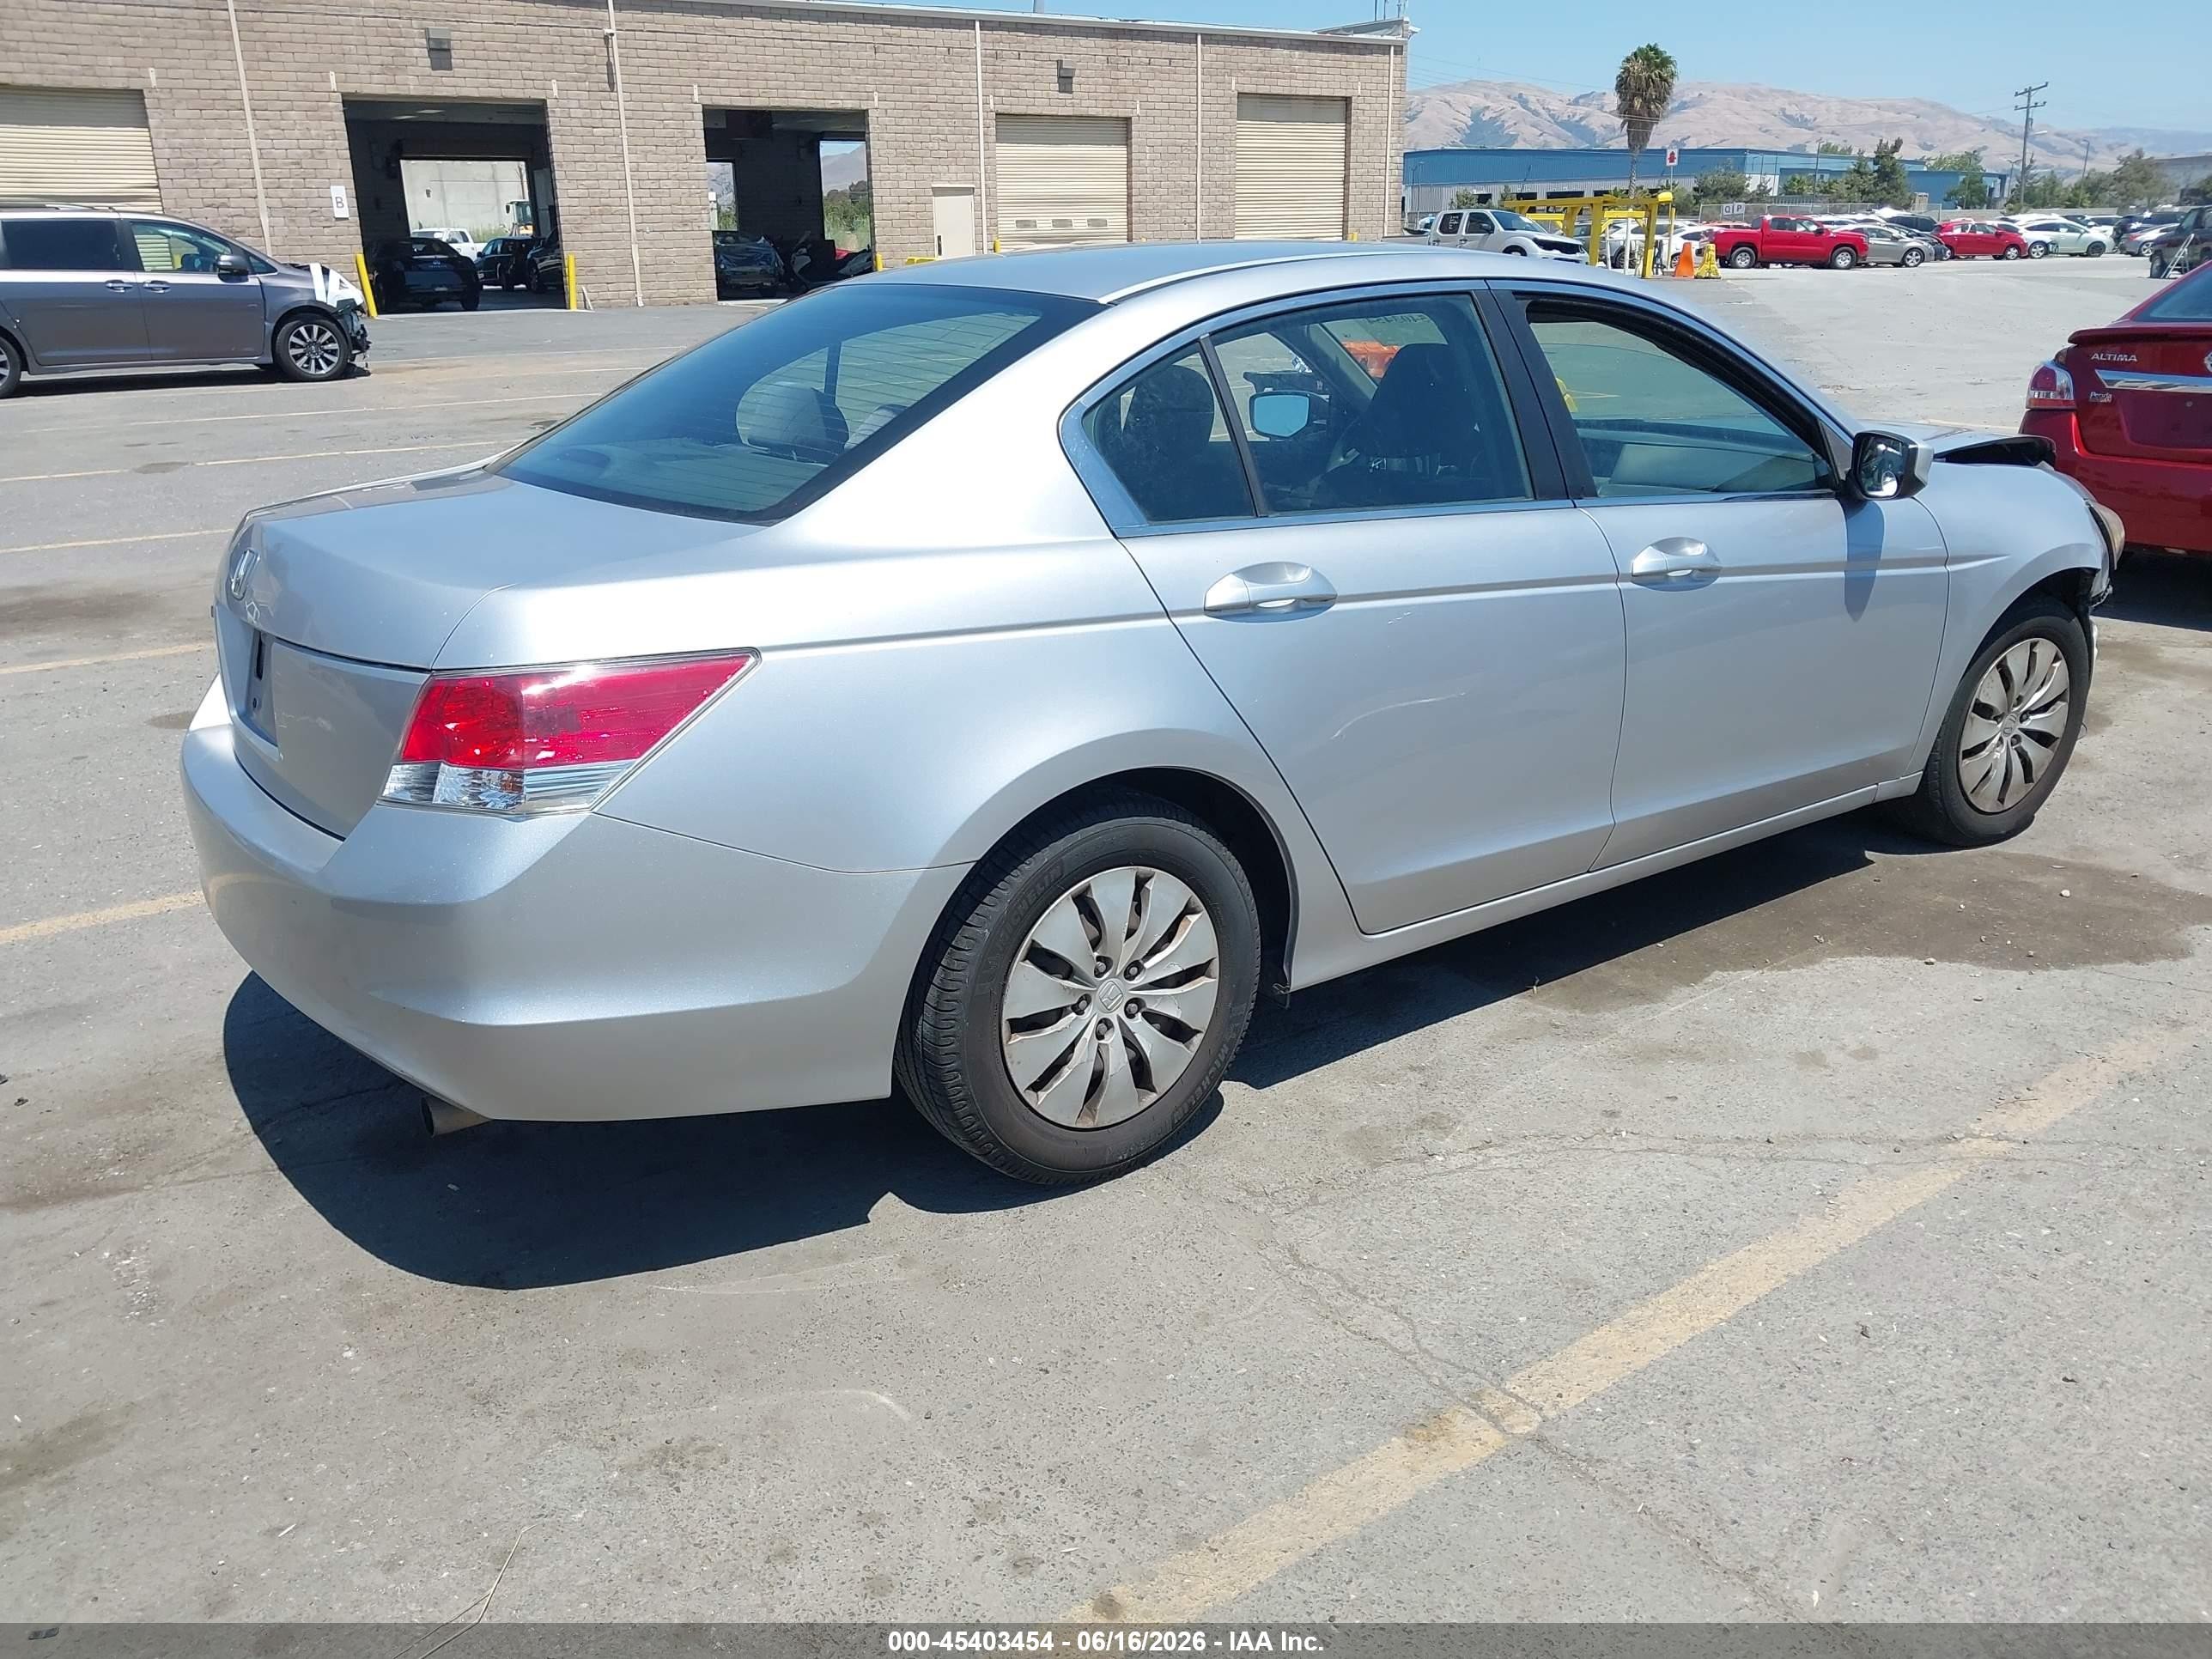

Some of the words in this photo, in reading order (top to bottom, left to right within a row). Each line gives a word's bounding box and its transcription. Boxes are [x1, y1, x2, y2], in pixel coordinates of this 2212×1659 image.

[335, 196, 344, 209] B
[2090, 353, 2138, 362] ALTIMA
[993, 860, 1065, 955] MICHELIN
[1172, 1042, 1231, 1127] MICHELIN
